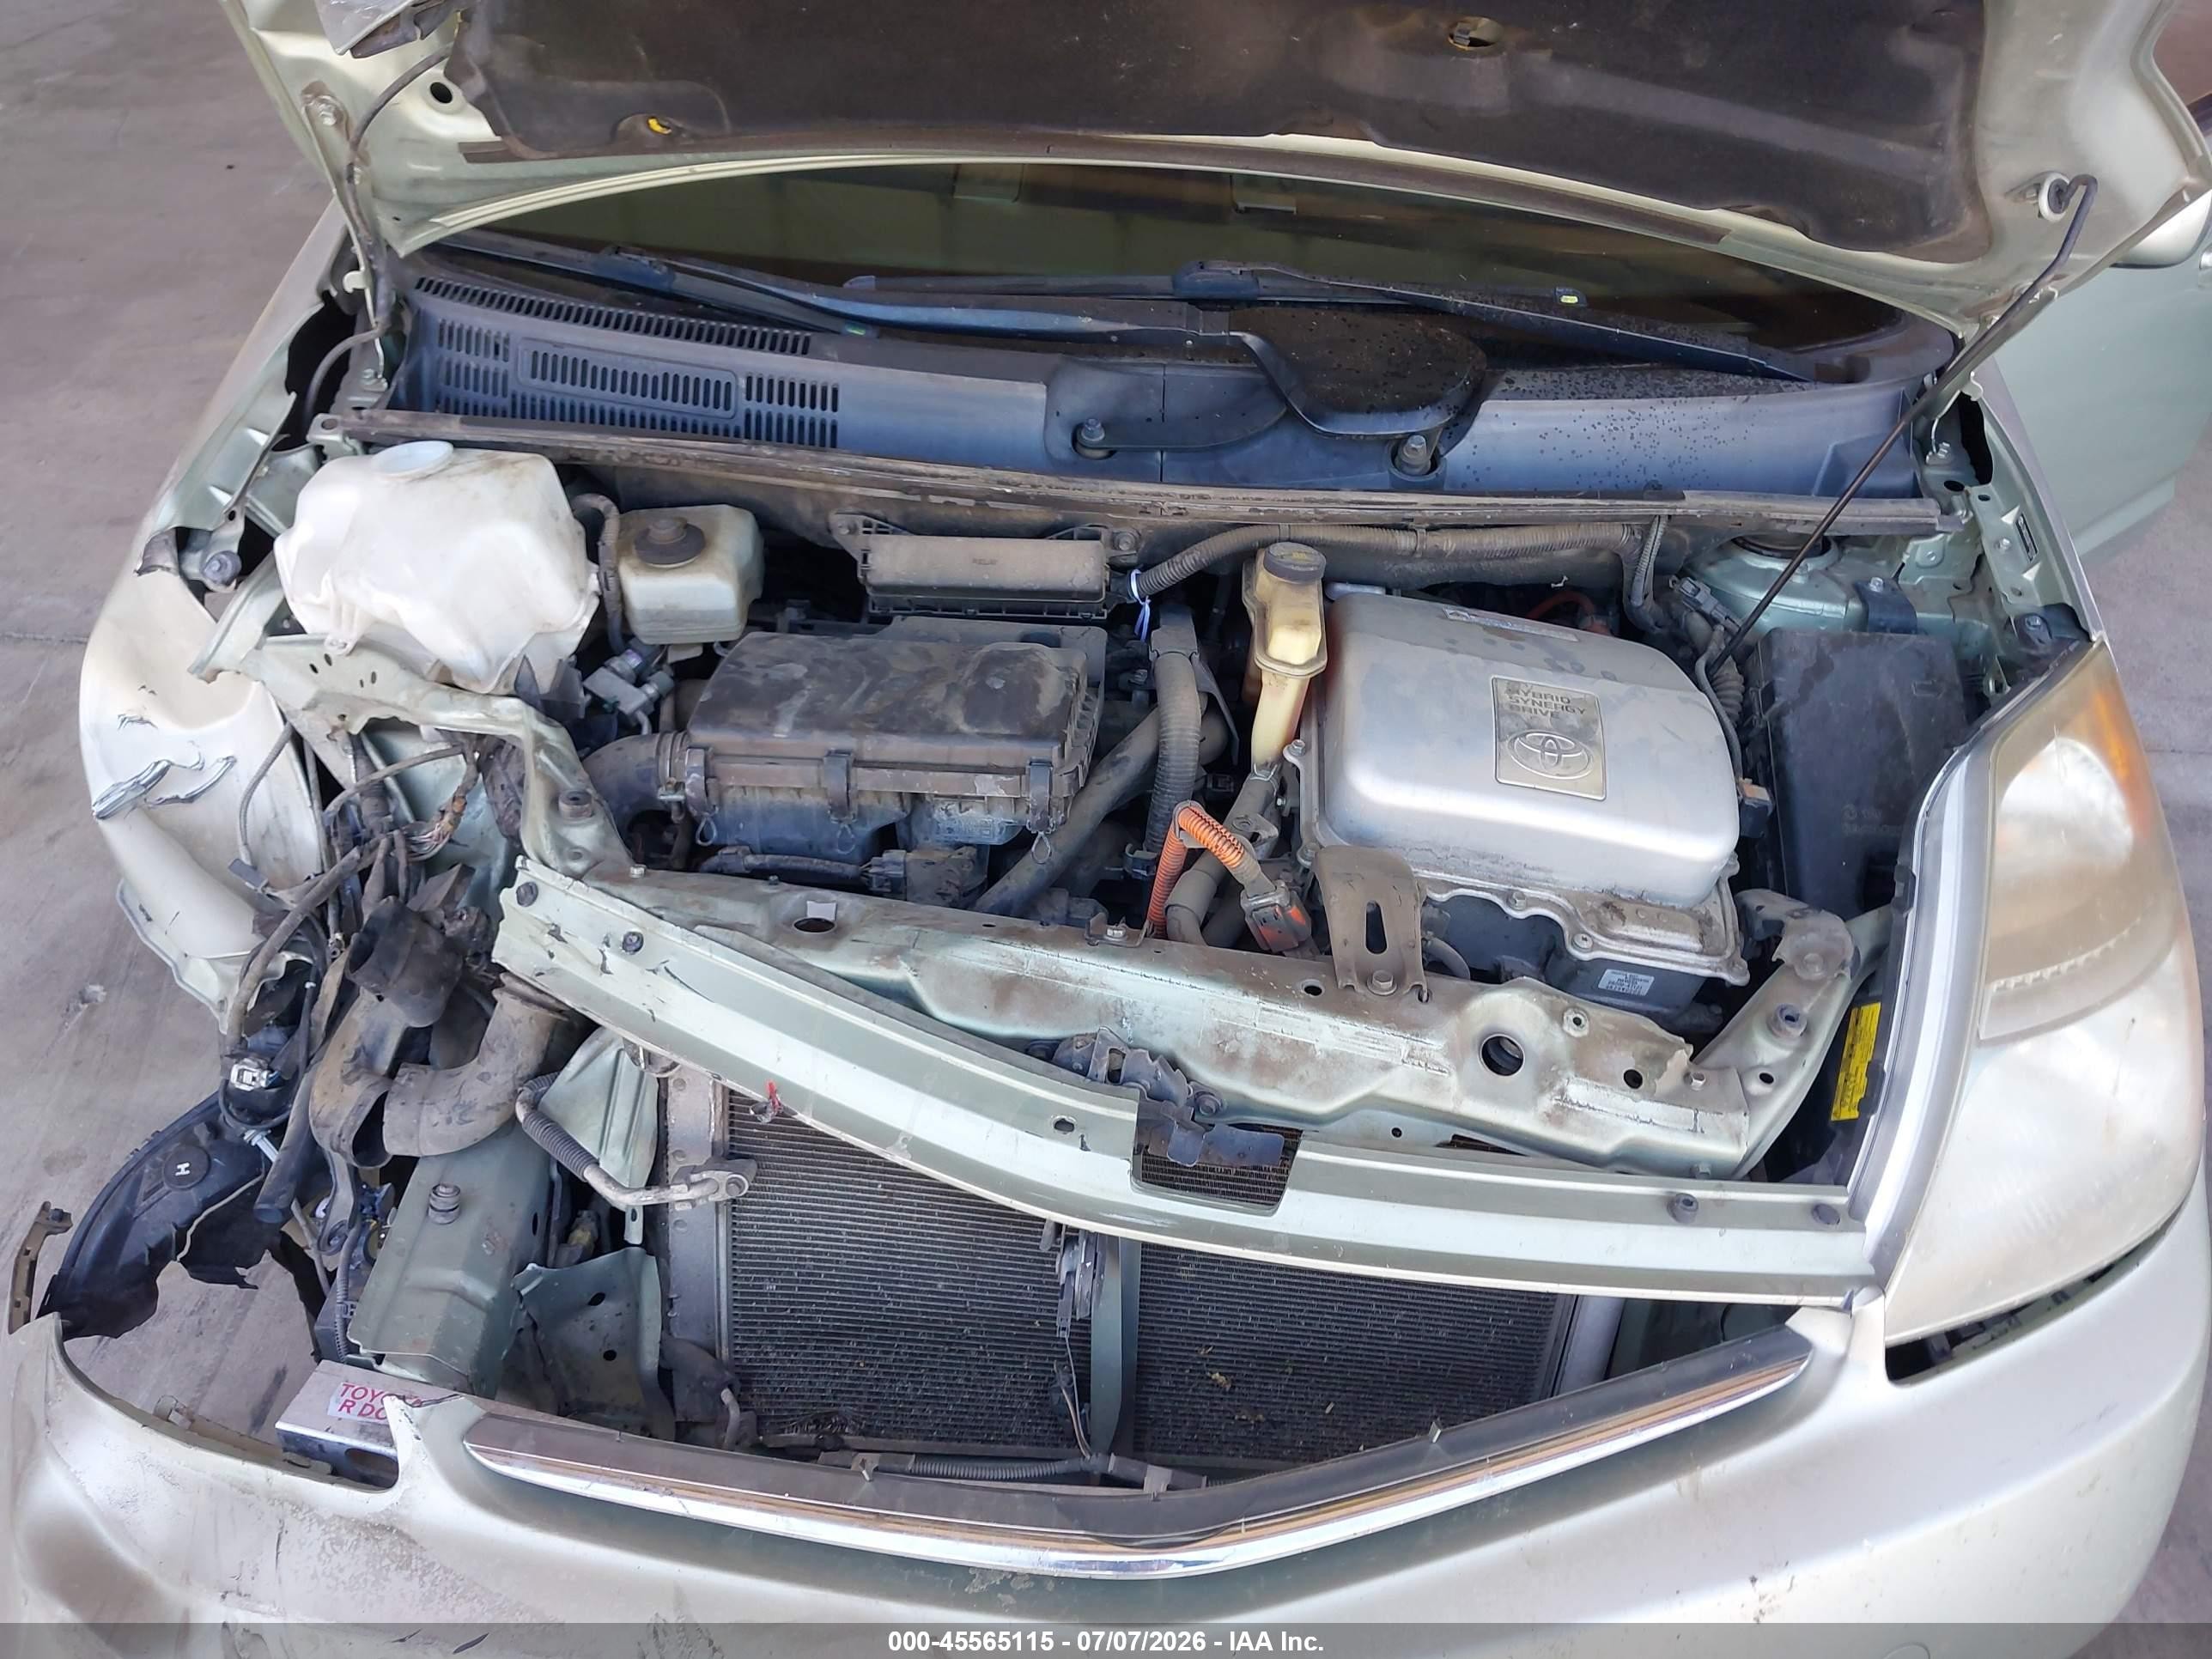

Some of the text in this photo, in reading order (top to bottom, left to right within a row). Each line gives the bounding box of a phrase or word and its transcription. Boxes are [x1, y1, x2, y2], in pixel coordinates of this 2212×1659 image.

[1509, 696, 1586, 715] SYNERGY
[1509, 704, 1560, 720] DRIVE
[337, 1398, 356, 1414] R
